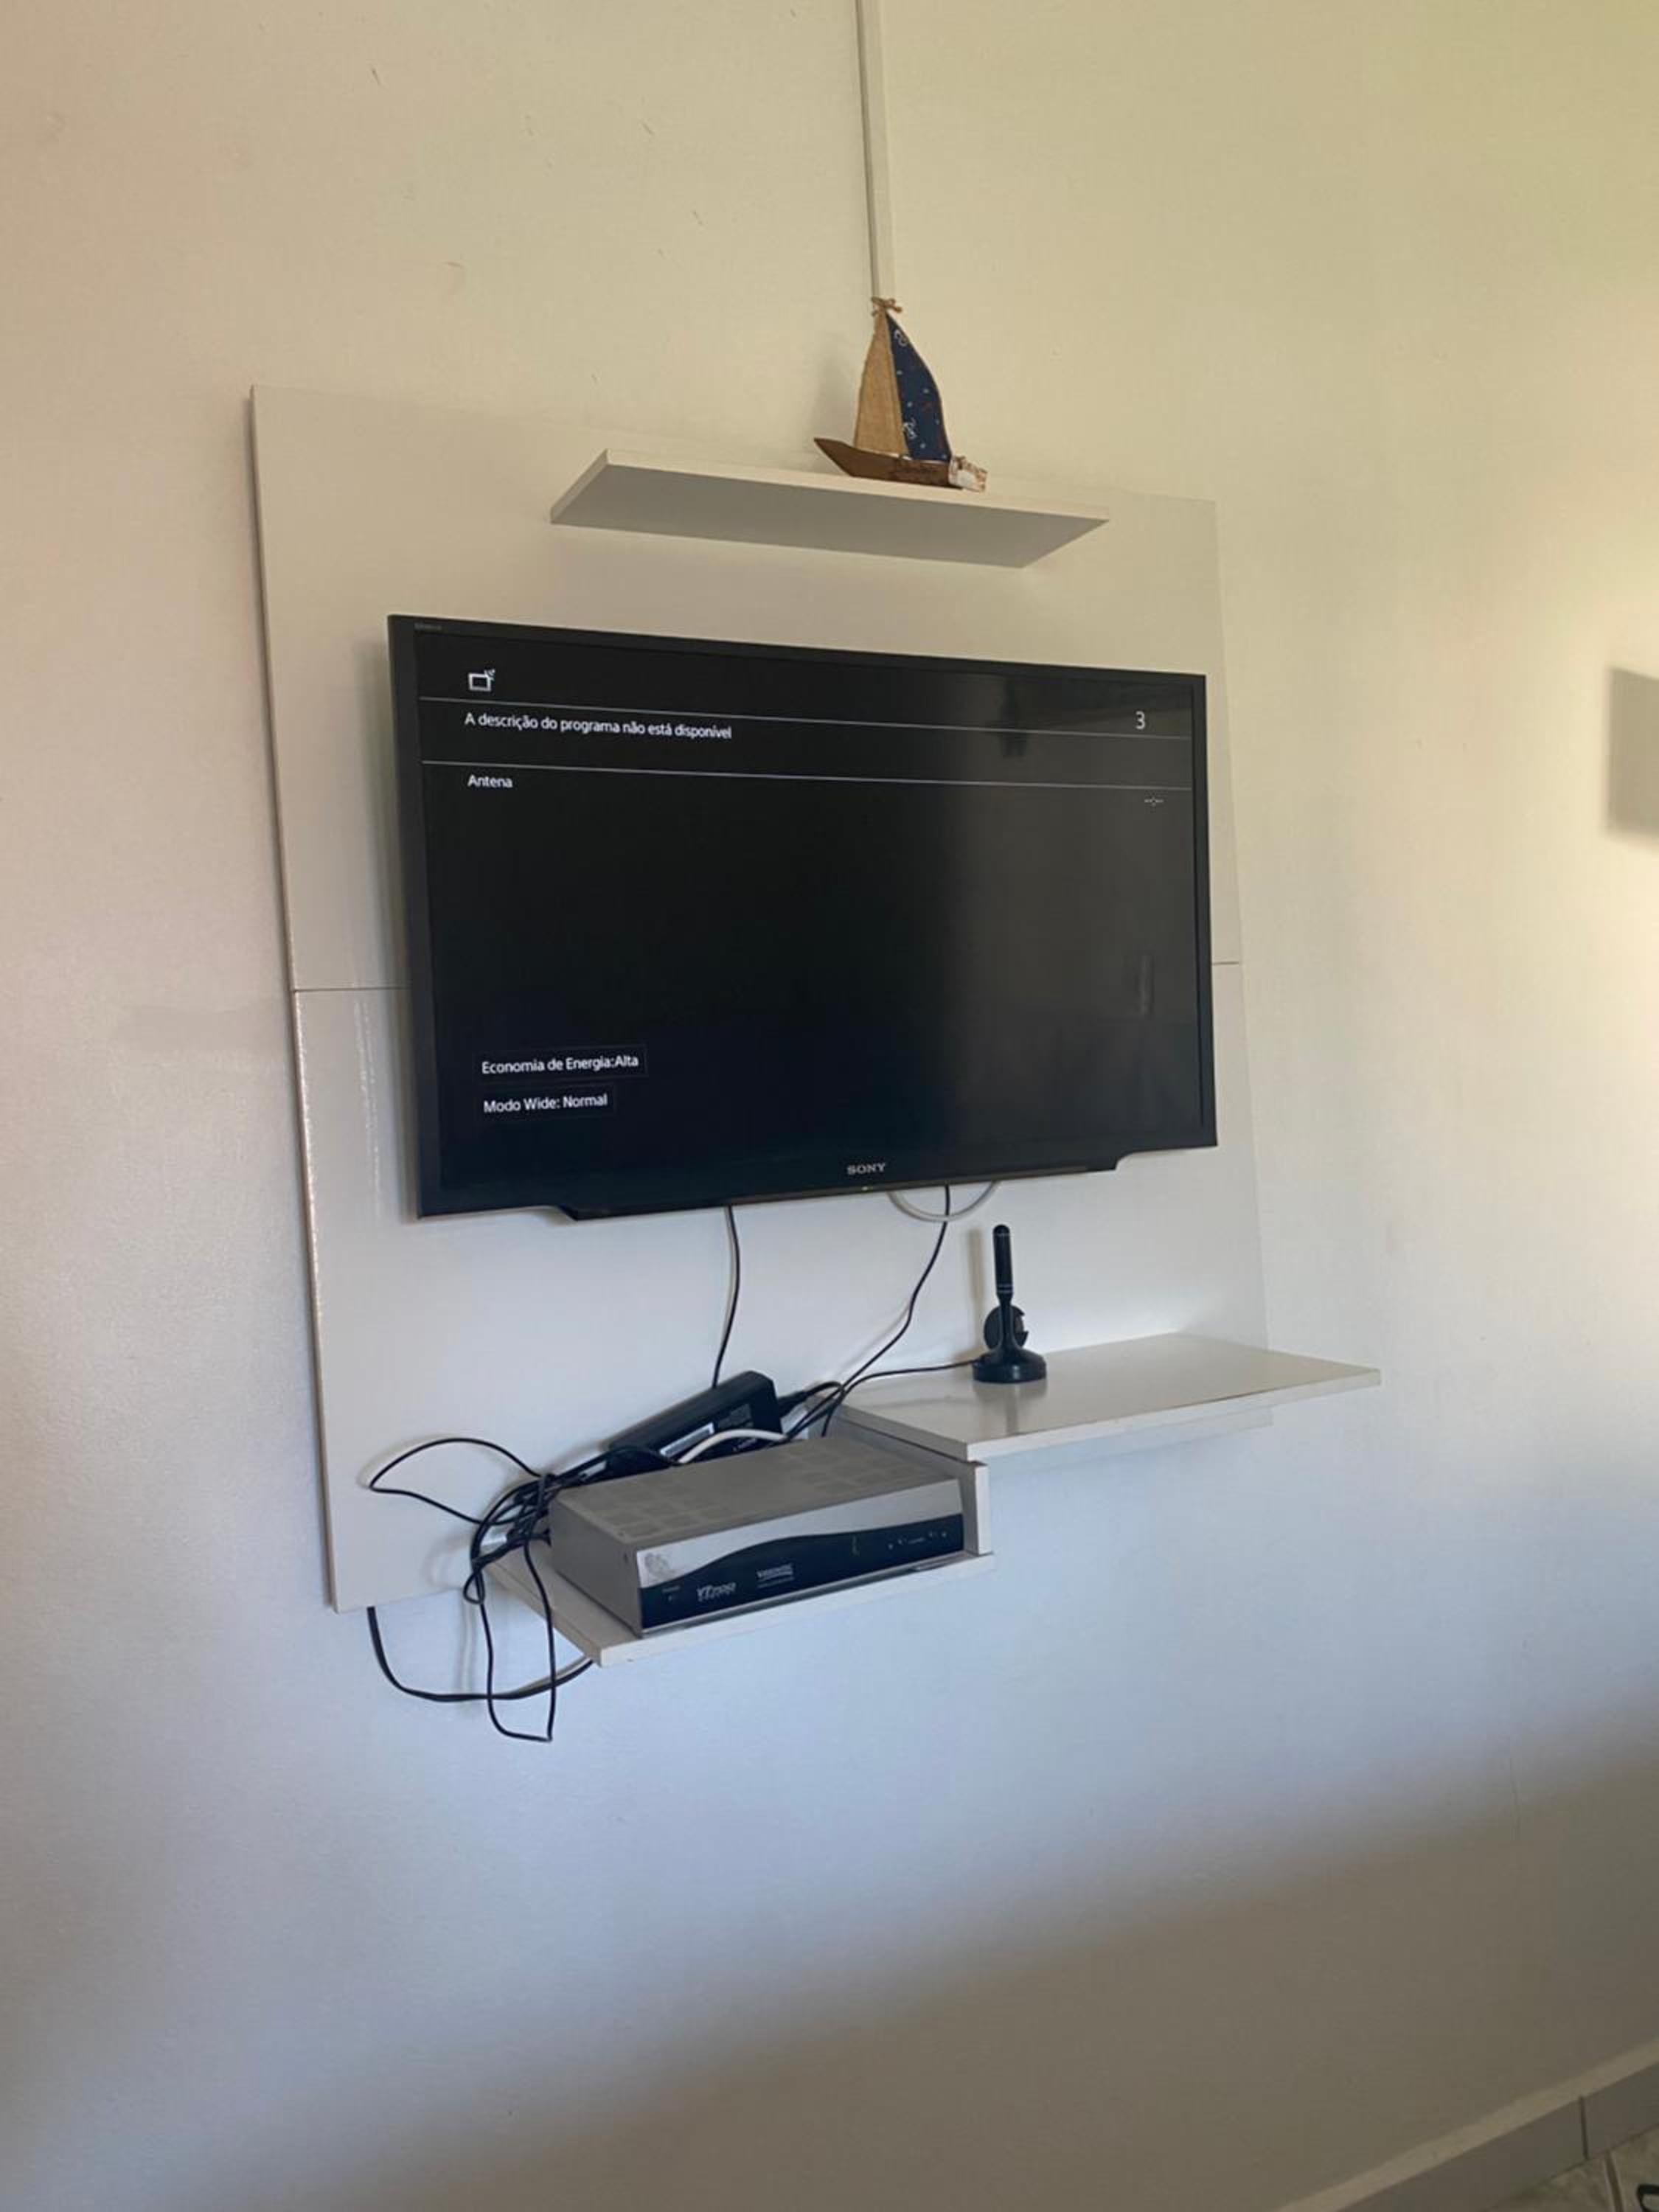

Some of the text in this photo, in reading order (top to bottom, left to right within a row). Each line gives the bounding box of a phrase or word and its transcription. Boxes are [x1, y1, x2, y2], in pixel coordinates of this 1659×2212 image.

[465, 712, 476, 726] A
[479, 713, 538, 730] descrição
[541, 717, 557, 729] do
[560, 720, 620, 734] programa
[622, 721, 646, 734] não
[647, 723, 672, 736] está
[1135, 711, 1145, 729] 3
[467, 774, 513, 787] Antena
[481, 1059, 544, 1074] Economia
[547, 1057, 563, 1071] de
[484, 1093, 607, 1113] Modo Wide: Normal
[847, 1163, 886, 1175] SONY
